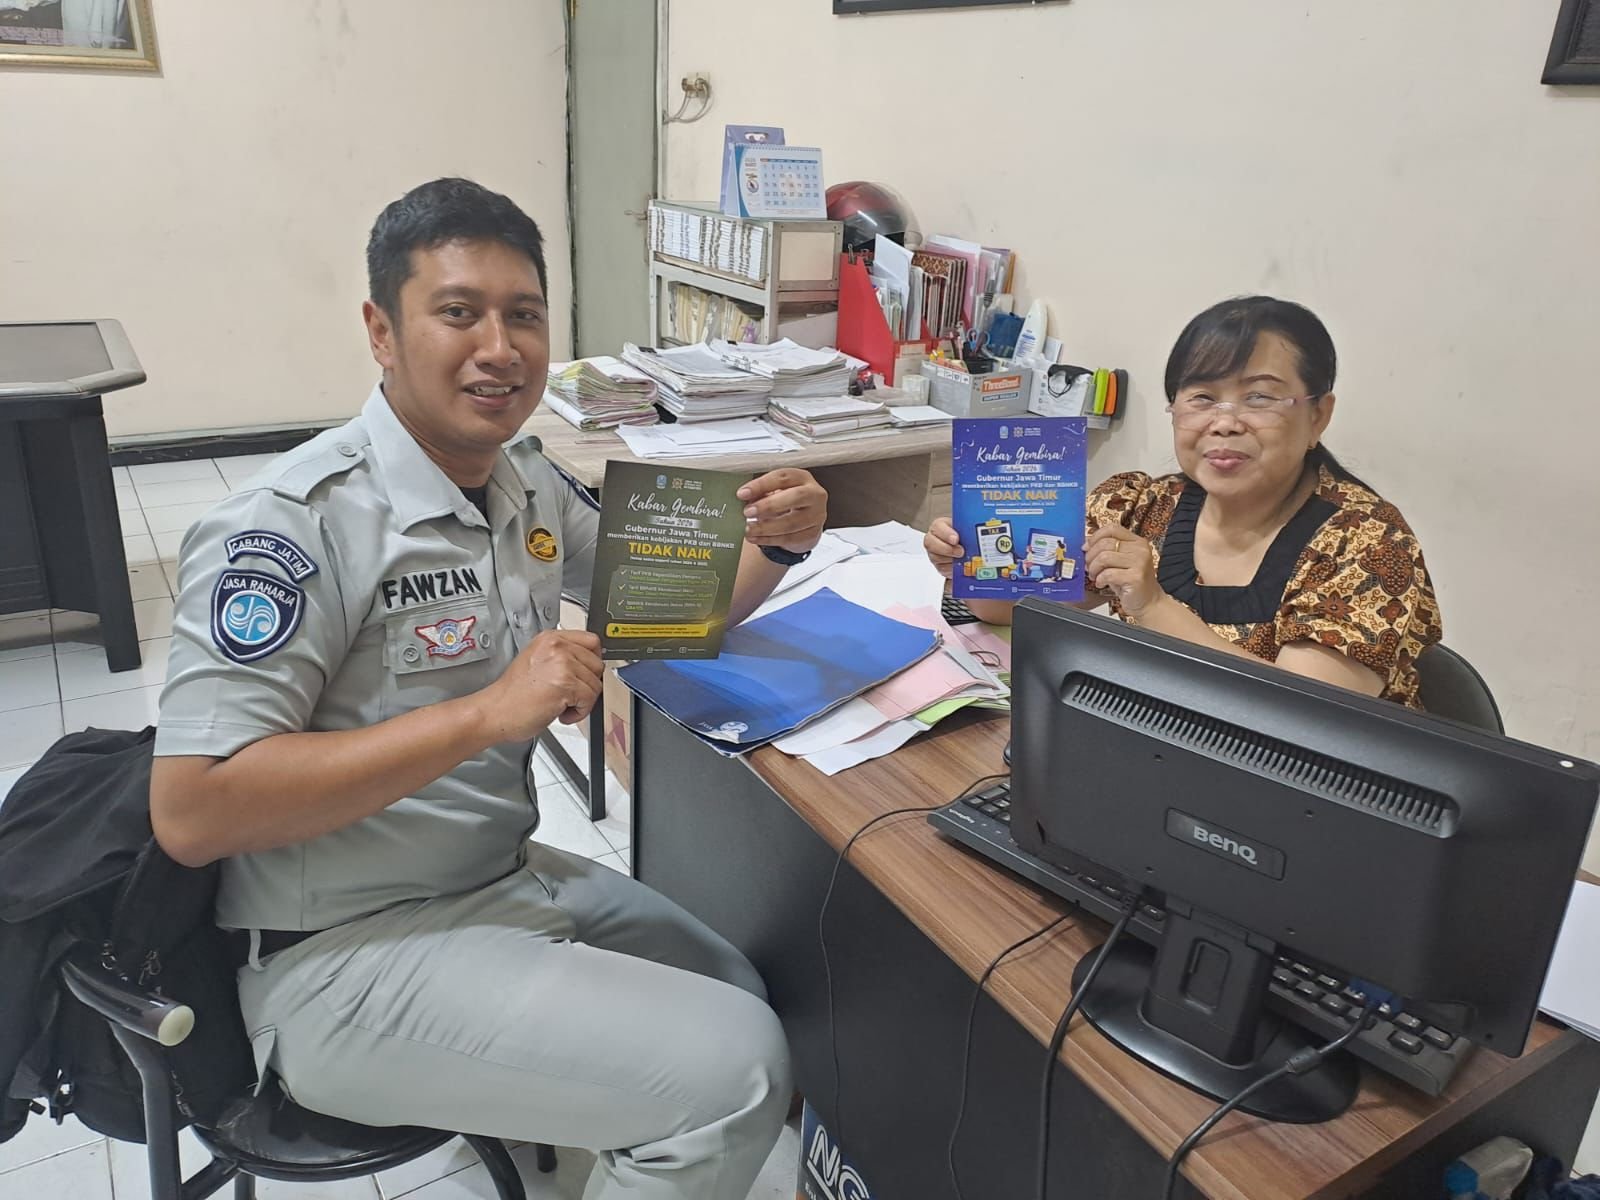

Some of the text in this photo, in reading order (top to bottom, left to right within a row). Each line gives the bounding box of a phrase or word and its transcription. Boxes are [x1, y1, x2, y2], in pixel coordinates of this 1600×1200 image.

[976, 443, 1066, 465] Kabar Gembira!
[627, 493, 727, 519] Kabar Gembira!
[981, 490, 1058, 501] TIDAK NAIK
[606, 532, 649, 541] memberikan
[650, 535, 683, 545] kebijakan
[683, 539, 697, 547] PKB
[624, 524, 718, 540] Gubernur Jawa Timur
[231, 537, 308, 574] CABANG JATIM
[628, 542, 672, 557] TIDAK
[676, 547, 713, 561] NAIK
[1000, 540, 1011, 549] Rp
[223, 578, 296, 607] JASA RAHARJA
[382, 568, 482, 609] FAWZAN
[1194, 825, 1258, 865] BenQ
